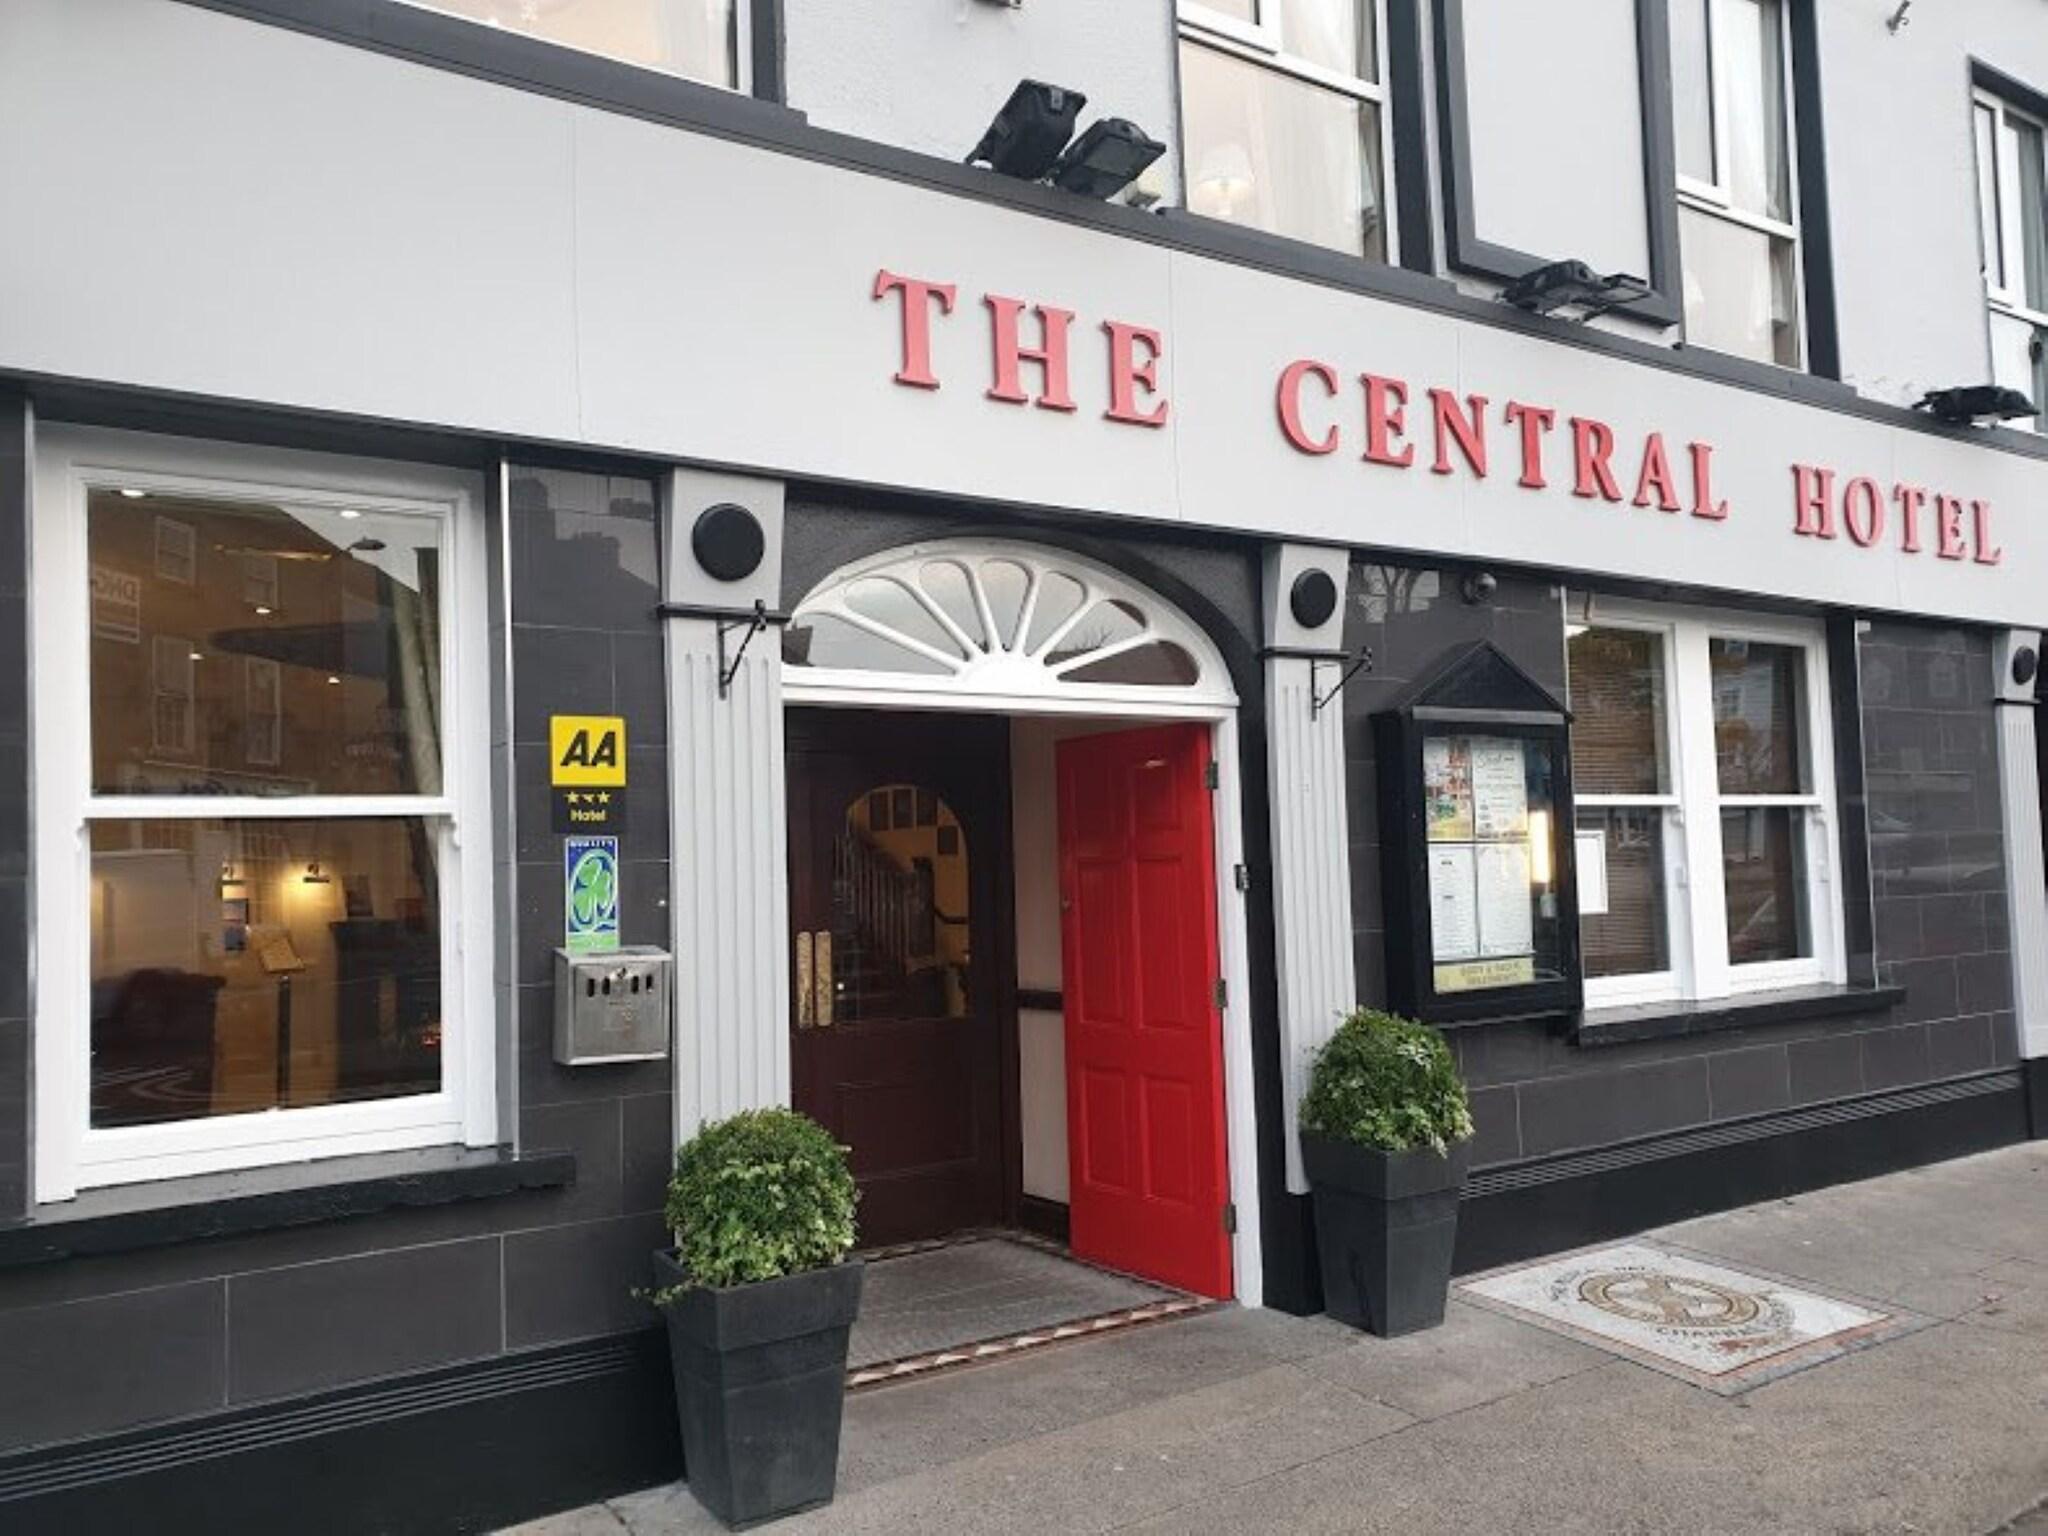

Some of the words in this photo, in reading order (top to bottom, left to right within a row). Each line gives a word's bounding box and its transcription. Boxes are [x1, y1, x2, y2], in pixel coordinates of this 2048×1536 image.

[873, 269, 1168, 427] THE
[1277, 359, 1729, 521] CENTRAL
[1791, 463, 2001, 565] HOTEL
[560, 729, 617, 767] AA
[570, 809, 606, 821] Hotel
